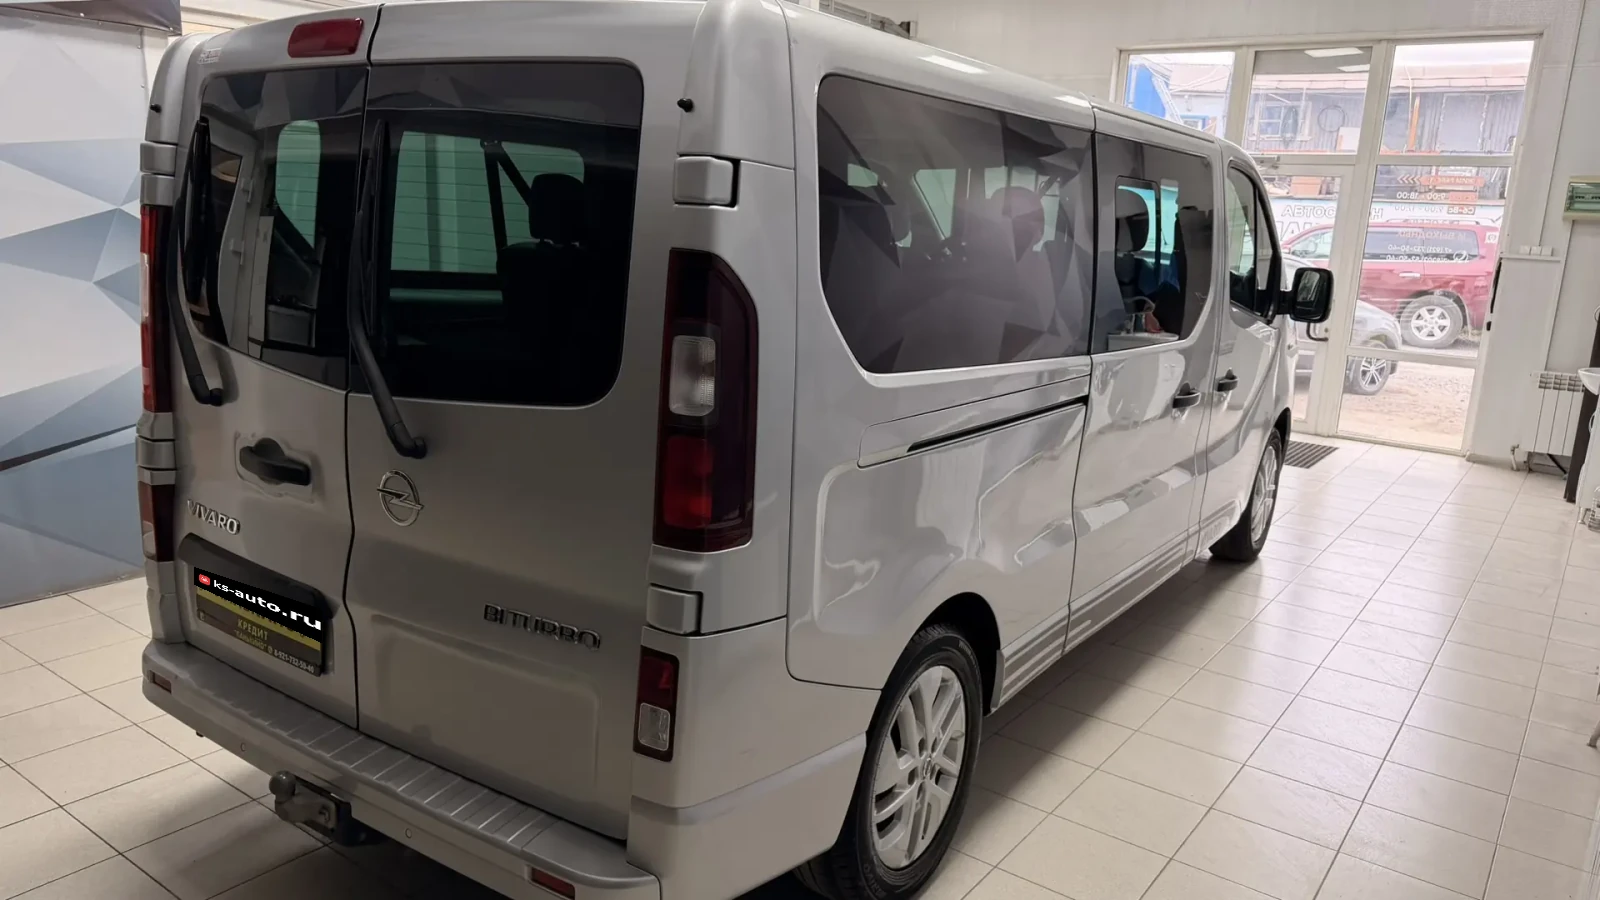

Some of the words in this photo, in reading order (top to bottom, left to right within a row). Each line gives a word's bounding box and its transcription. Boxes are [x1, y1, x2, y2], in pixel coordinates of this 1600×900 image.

[187, 499, 241, 535] VIVARO
[236, 618, 268, 641] КРЕДИТ
[484, 603, 601, 651] BITURBO
